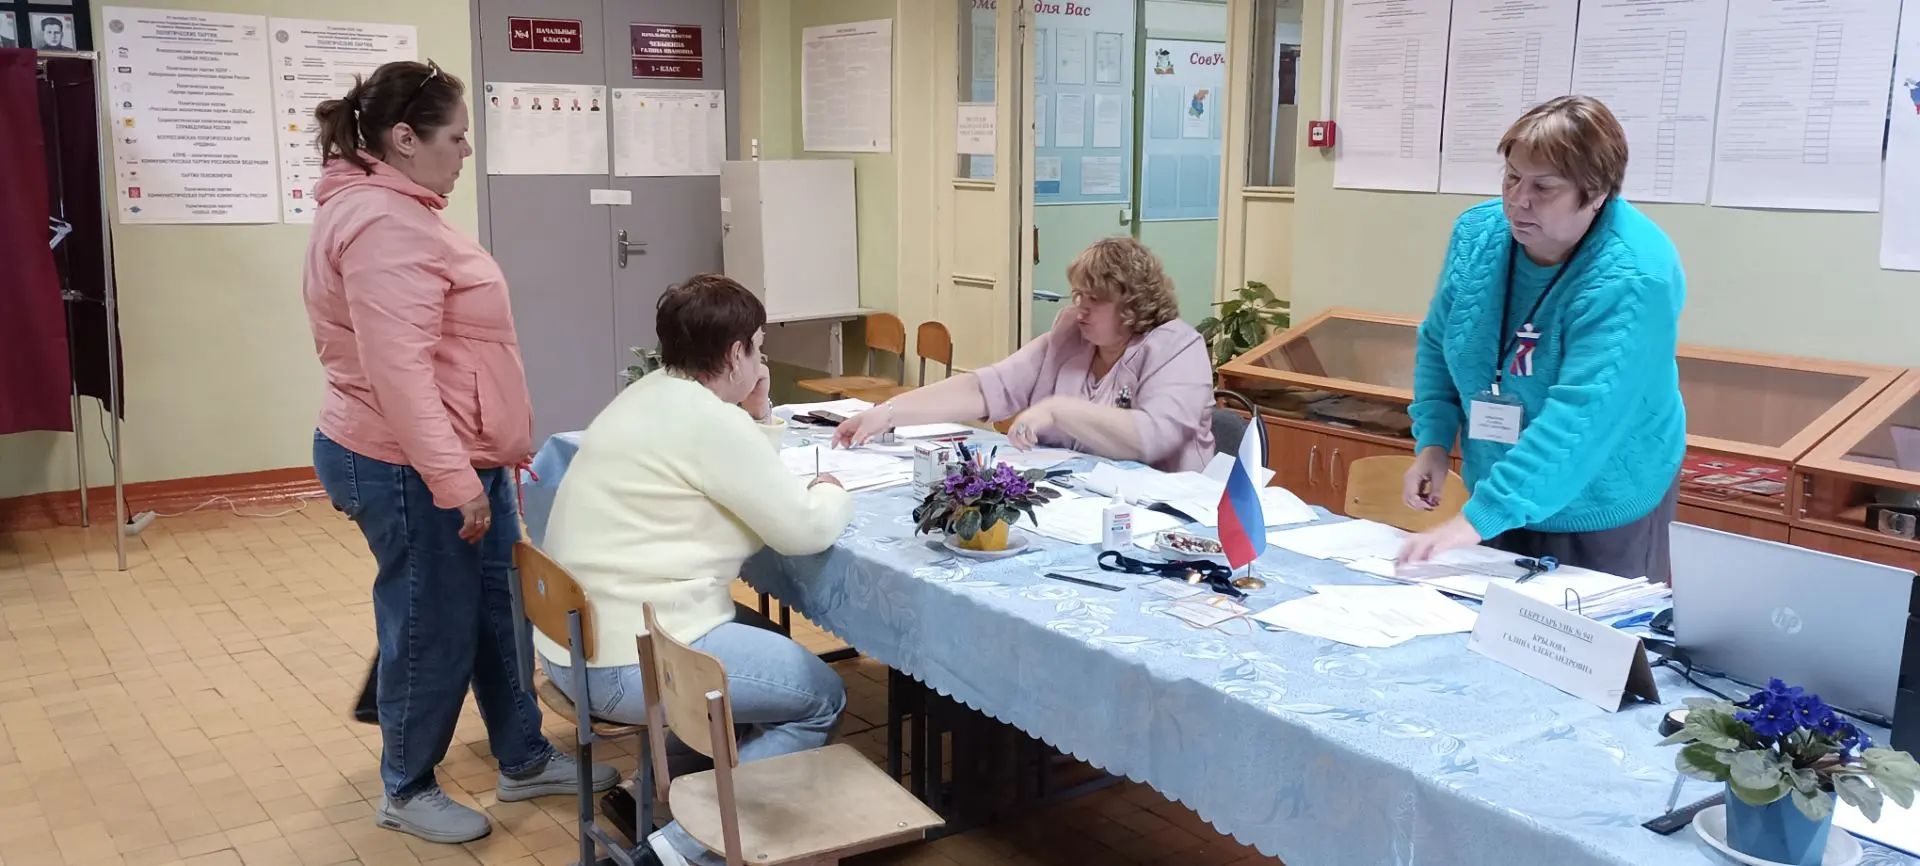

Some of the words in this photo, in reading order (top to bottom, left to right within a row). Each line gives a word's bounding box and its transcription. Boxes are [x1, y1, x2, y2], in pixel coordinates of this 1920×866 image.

[1034, 0, 1059, 15] для
[1065, 3, 1091, 17] Вас
[513, 30, 529, 39] №4
[536, 27, 577, 36] НАЧАЛЬНЫЕ
[543, 36, 571, 44] КЛАССЫ
[1519, 607, 1558, 628] СЕКРЕТАРЬ
[1559, 621, 1574, 634] УИК
[1771, 606, 1802, 635] hp
[1532, 633, 1566, 653] КРЫЛОВА
[1503, 631, 1530, 649] ГАЛИНА
[1532, 645, 1593, 675] АЛЕКСАНДРОВНА
